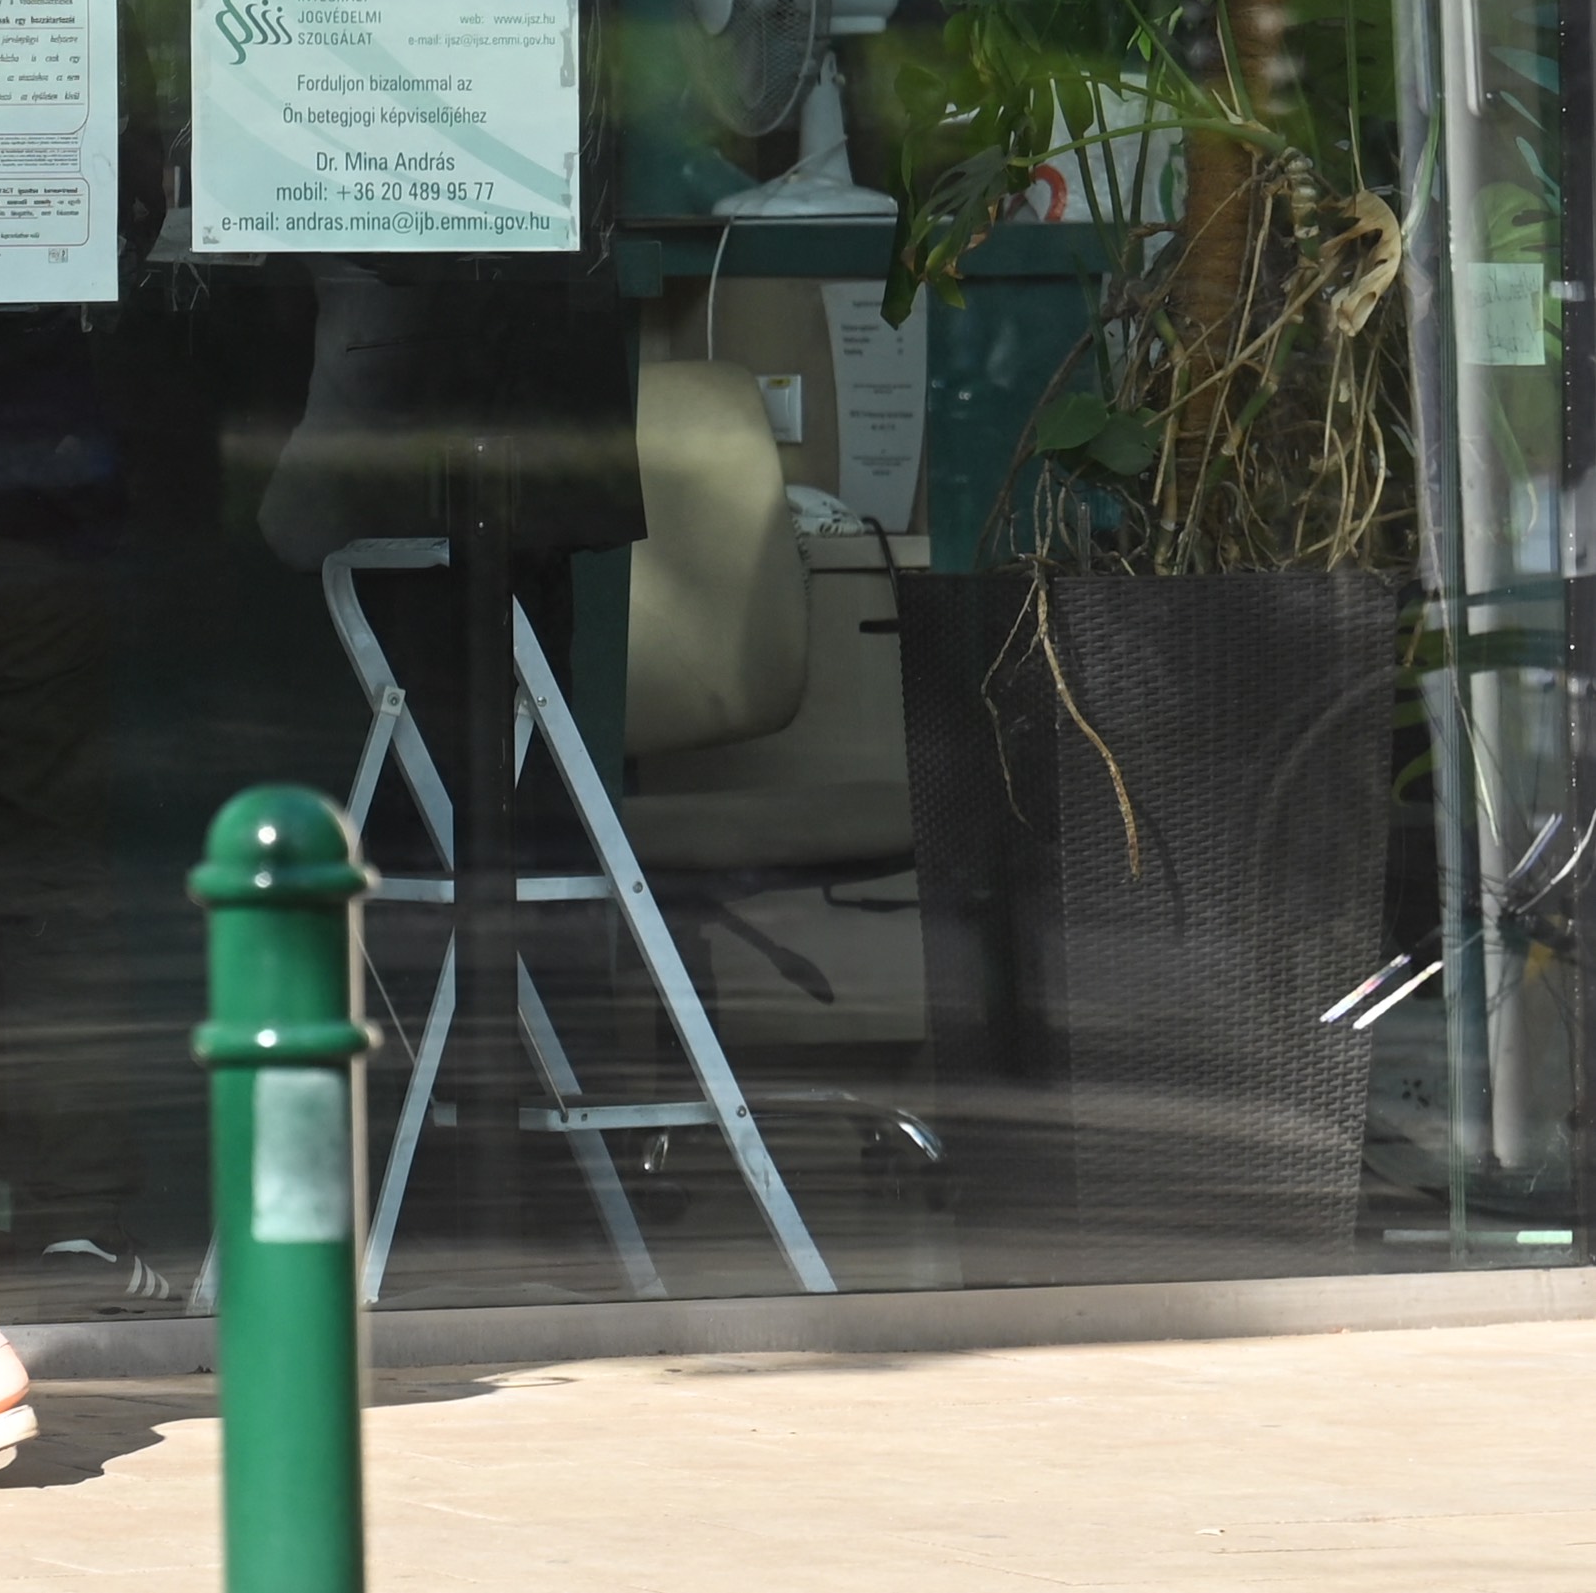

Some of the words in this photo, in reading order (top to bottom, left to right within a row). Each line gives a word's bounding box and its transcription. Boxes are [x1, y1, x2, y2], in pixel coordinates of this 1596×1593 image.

[297, 10, 382, 24] JOGVÉDELMI
[459, 13, 485, 25] web:
[493, 12, 556, 28] www.ijsz.hu
[297, 29, 373, 46] SZOLGÁLAT
[407, 33, 442, 46] e-mail:
[444, 33, 556, 49] ijsz@ijsz.emmi.gov.hu
[297, 73, 365, 95] Forduljon
[369, 74, 452, 92] bizalommal
[456, 78, 473, 92] az
[282, 102, 303, 124] Ön
[307, 106, 376, 128] betegjogi
[380, 106, 487, 128] képviselőjéhez
[316, 151, 338, 172] Dr.
[345, 151, 389, 172] Mina
[393, 151, 455, 172] András
[276, 181, 328, 202] mobil:
[336, 181, 375, 202] +36
[380, 181, 403, 202] 20
[408, 181, 441, 201] 489
[446, 181, 468, 201] 95
[473, 181, 494, 201] 77
[221, 211, 280, 231] e-mail:
[285, 210, 551, 236] andras.mina@ijb.emmi.gov.hu
